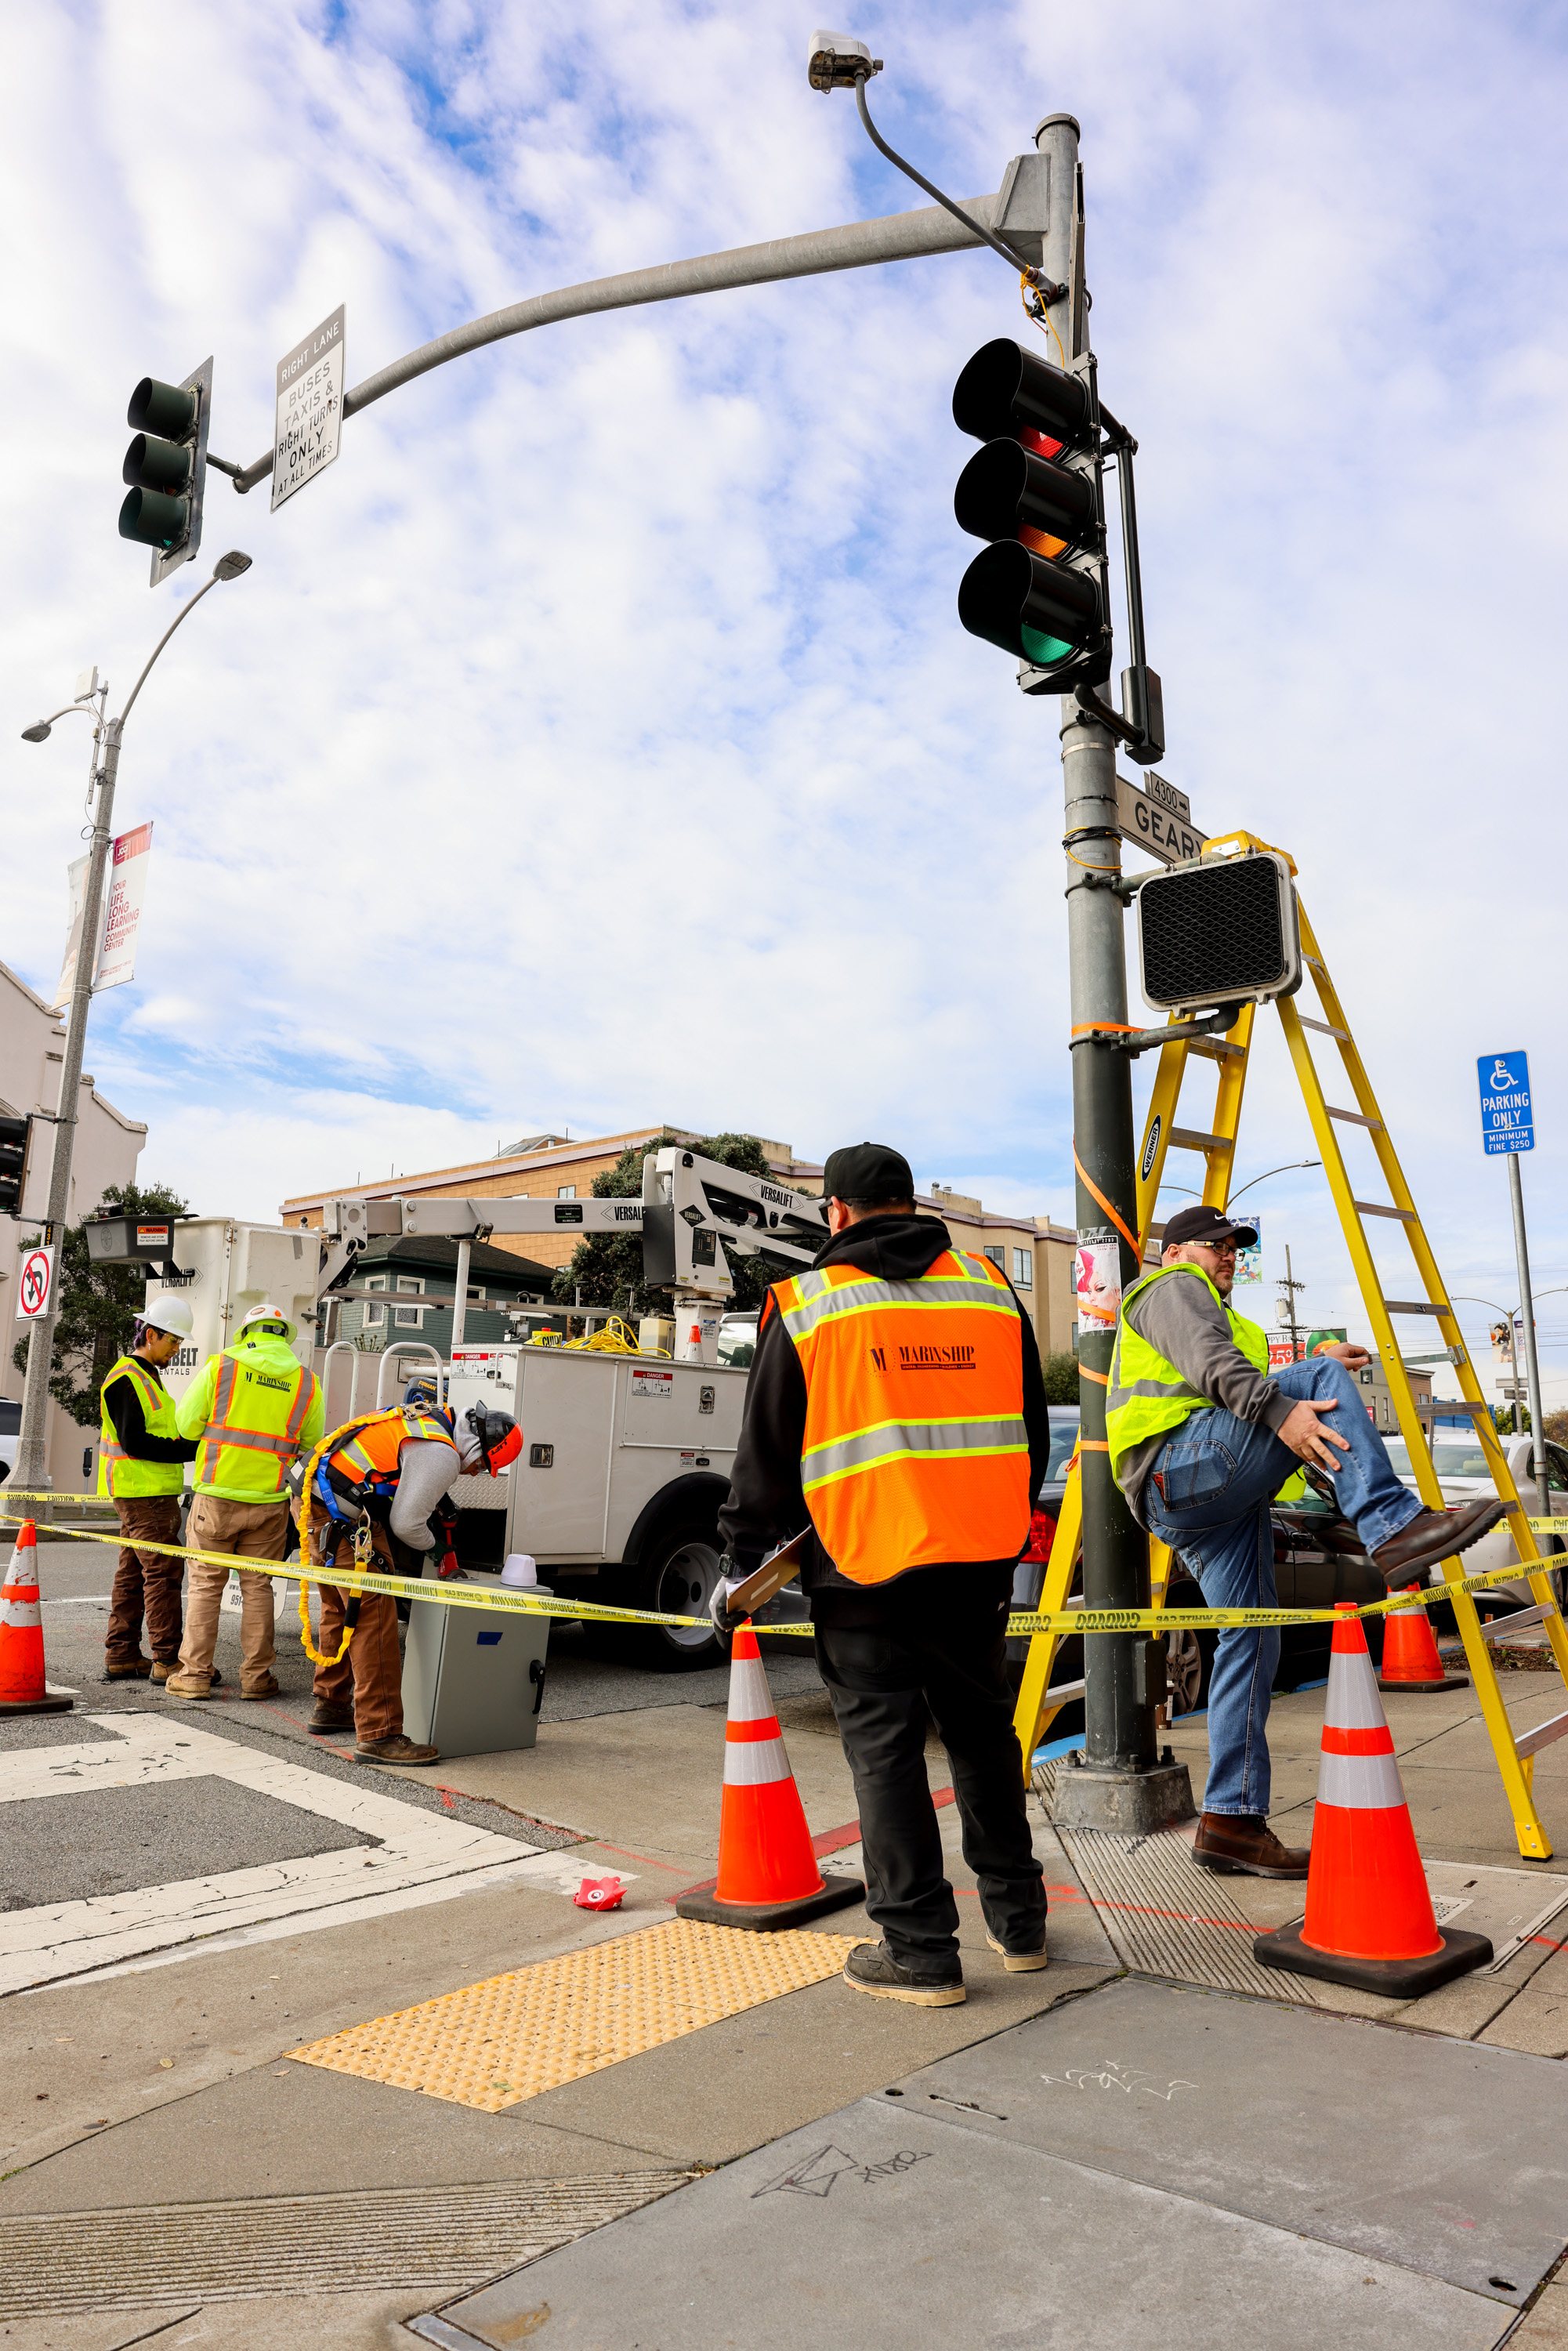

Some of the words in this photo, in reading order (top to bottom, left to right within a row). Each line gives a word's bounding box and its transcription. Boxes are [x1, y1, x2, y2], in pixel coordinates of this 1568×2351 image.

[281, 349, 309, 383] RIGHT
[313, 321, 339, 354] LANE
[289, 361, 331, 408] BUSES
[284, 390, 320, 431] TAXIS
[326, 380, 334, 397] &
[278, 426, 305, 458] RIGHT
[310, 395, 339, 432] TURNS
[289, 426, 324, 469] ONLY
[278, 479, 288, 496] AT
[290, 468, 305, 486] ALL
[309, 440, 332, 470] TIMES
[1154, 781, 1178, 809] 4300
[113, 879, 126, 894] YOUR
[110, 891, 124, 907] LIFE
[107, 907, 139, 933] LEARNING
[108, 900, 129, 920] LONG
[105, 922, 138, 944] COMMUNITY
[104, 938, 125, 953] CENTER
[1483, 1092, 1529, 1112] PARKING
[1493, 1110, 1521, 1128] ONLY
[1489, 1130, 1528, 1143] MINIMUM
[1489, 1143, 1506, 1152] FINE
[1510, 1139, 1530, 1150] $250
[1145, 1127, 1158, 1168] WERNER
[761, 1184, 793, 1208] VERSALIFT
[614, 1206, 643, 1221] VERSAL
[684, 1211, 701, 1221] VERSALIFT
[1268, 1335, 1280, 1344] PPY
[1282, 1334, 1305, 1343] BAK
[871, 1348, 886, 1372] M
[899, 1346, 974, 1362] MARINSHIP
[159, 1367, 190, 1376] ENTALS
[257, 1375, 292, 1389] MARINSHIP
[418, 1381, 436, 1392] FIRMAN
